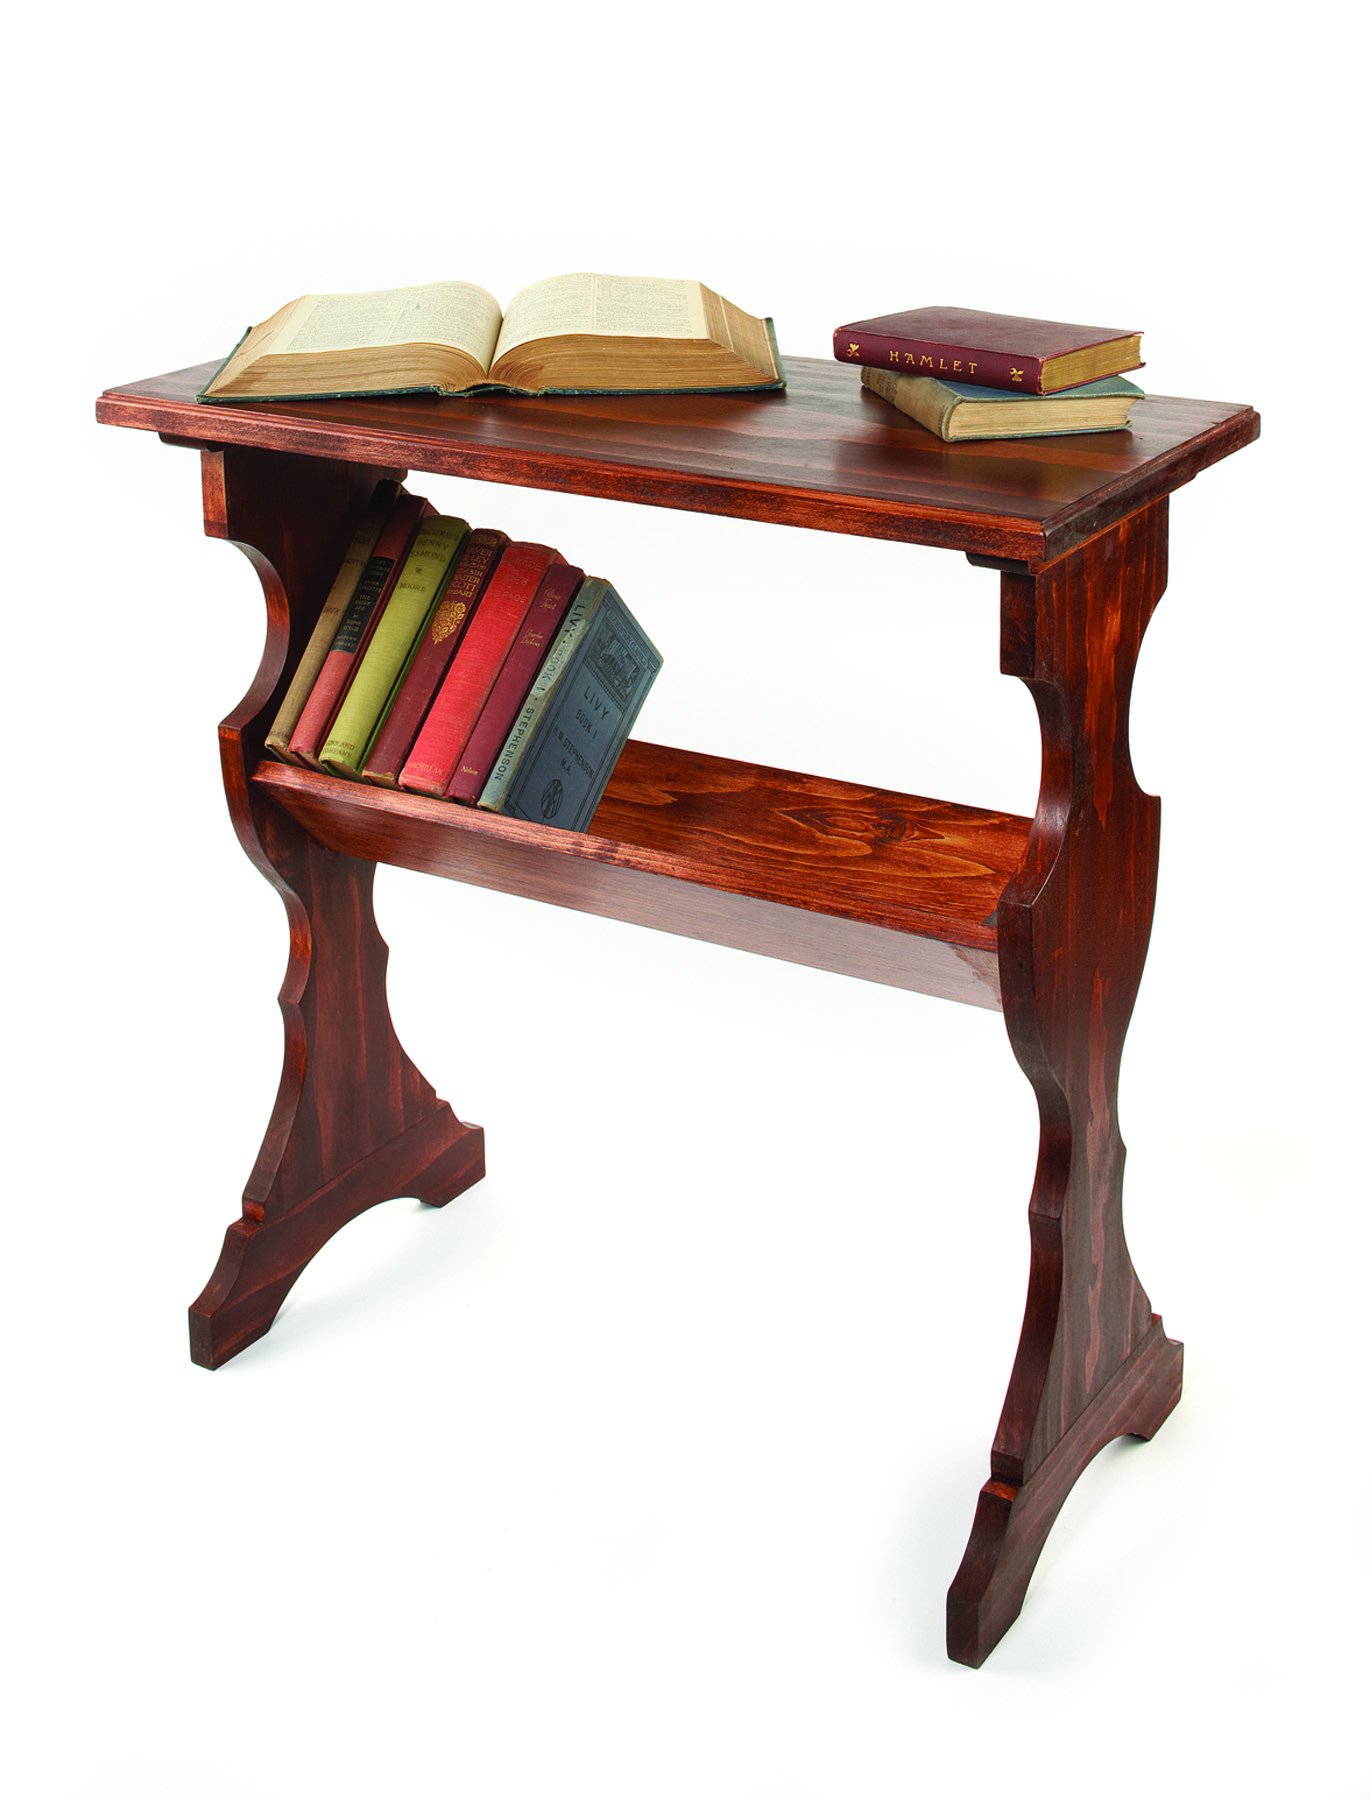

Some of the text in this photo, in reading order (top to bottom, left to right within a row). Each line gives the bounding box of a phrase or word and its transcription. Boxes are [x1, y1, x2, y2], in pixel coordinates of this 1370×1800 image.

[889, 350, 978, 374] HAMLET
[416, 540, 449, 551] HENRY
[409, 550, 447, 562] ESMOND
[469, 569, 483, 578] SIR
[399, 582, 425, 592] MOORE
[564, 604, 586, 637] LIVY
[542, 650, 564, 681] BOOK
[584, 686, 609, 719] LIVY
[575, 708, 594, 734] BOOK
[494, 706, 535, 781] STEPHENSON
[408, 762, 443, 775] MACMILLAN
[461, 765, 478, 775] Nelson
